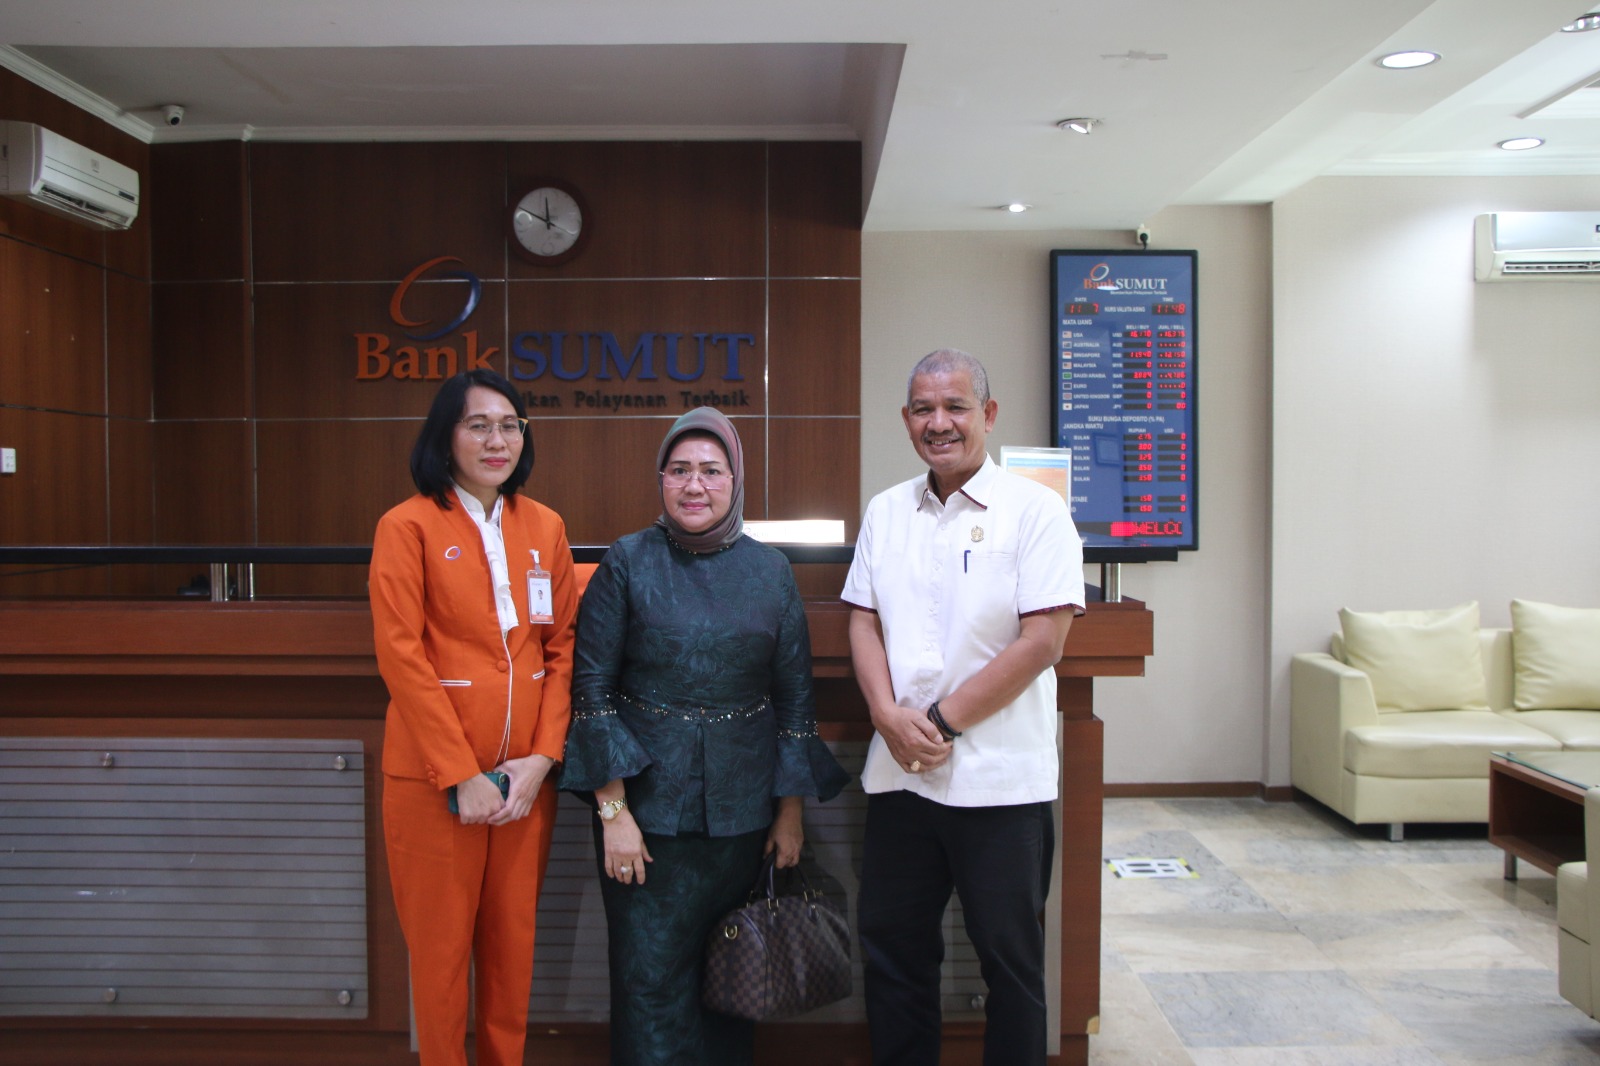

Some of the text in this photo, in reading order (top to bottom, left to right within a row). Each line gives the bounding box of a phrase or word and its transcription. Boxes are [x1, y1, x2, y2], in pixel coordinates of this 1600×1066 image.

[1083, 278, 1168, 290] Bank SUMUT
[353, 330, 756, 384] Bank SUMUT
[575, 391, 667, 412] Pelayanan
[681, 391, 749, 409] Terbaik
